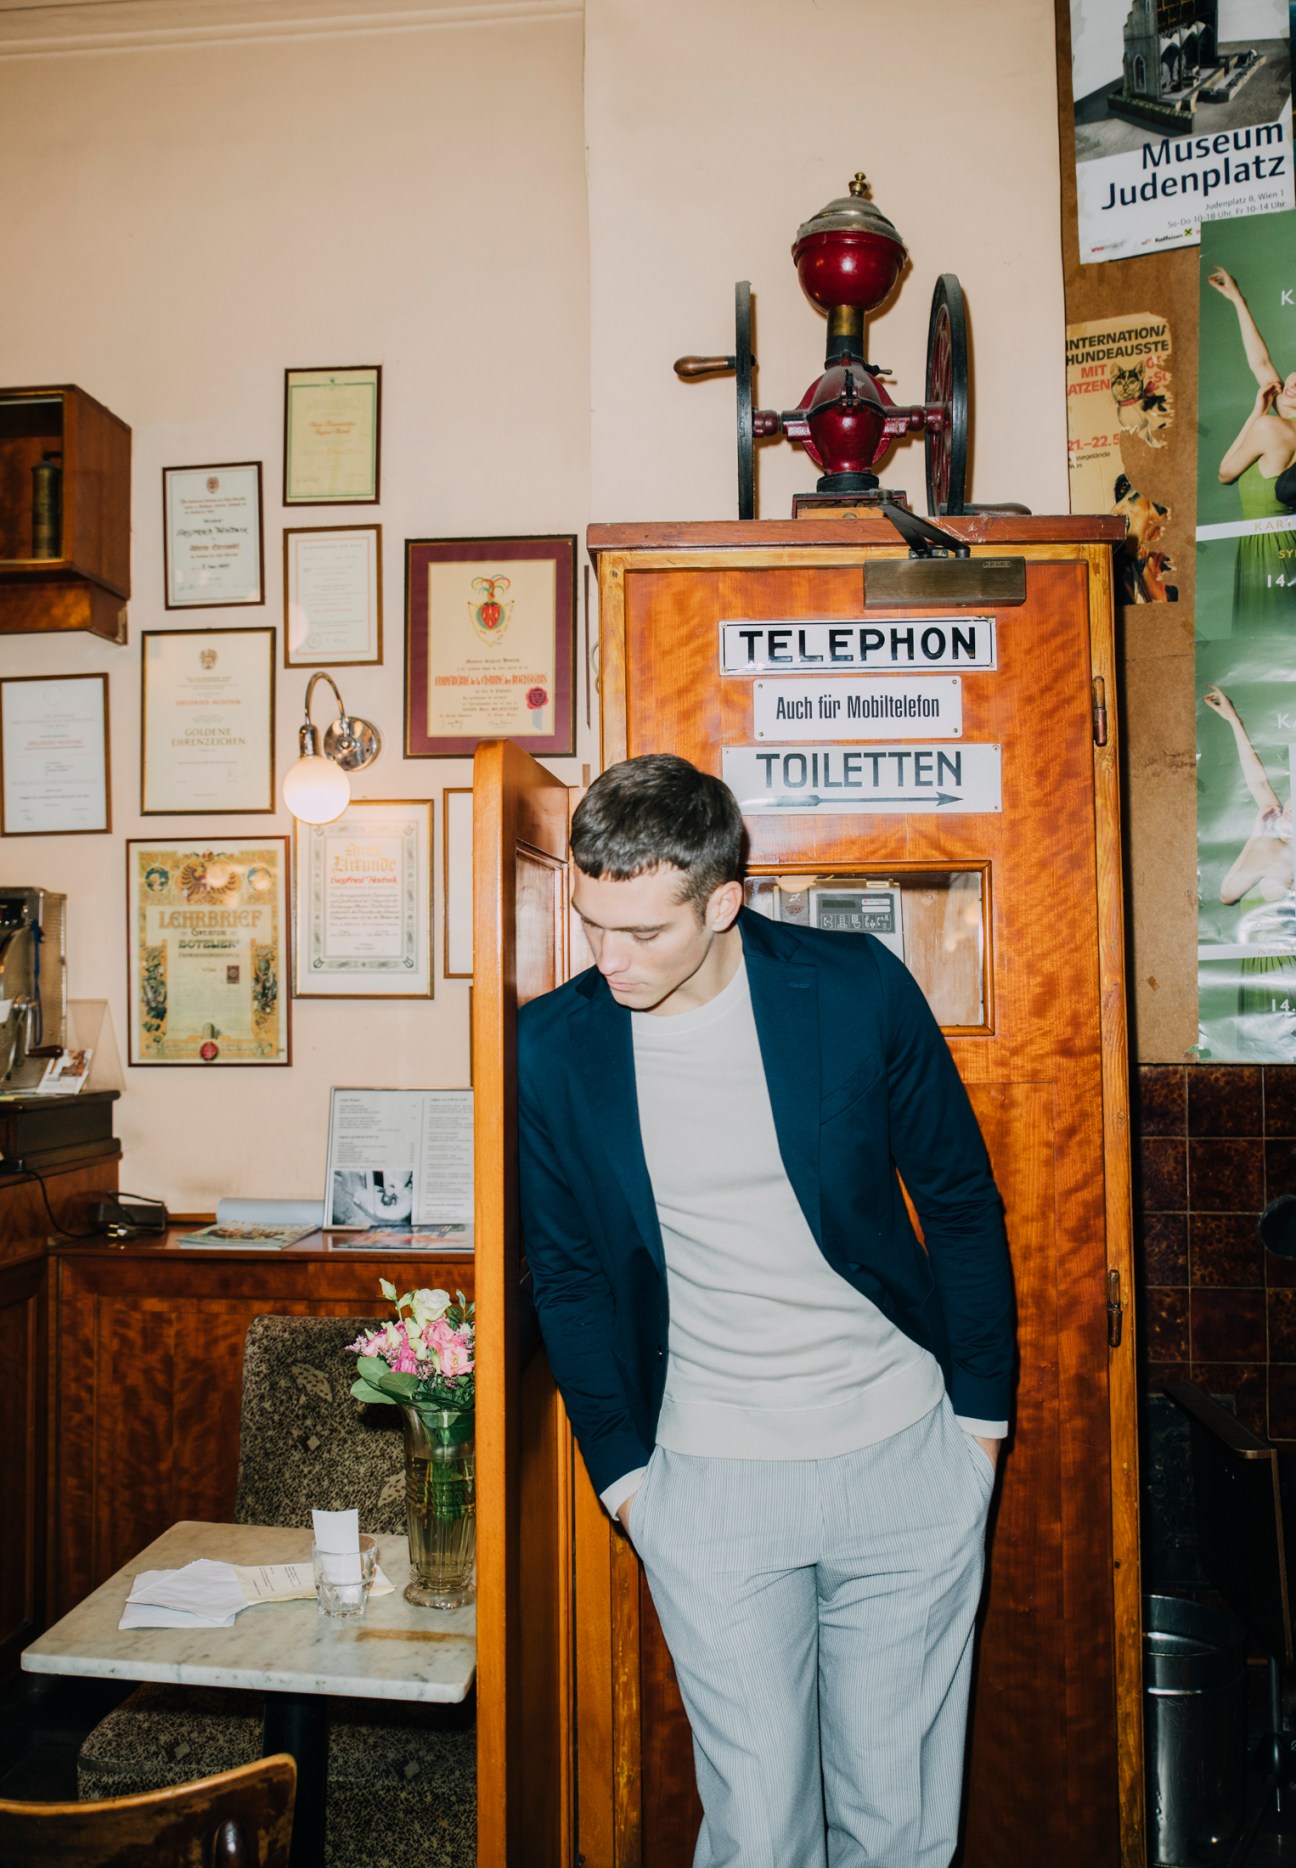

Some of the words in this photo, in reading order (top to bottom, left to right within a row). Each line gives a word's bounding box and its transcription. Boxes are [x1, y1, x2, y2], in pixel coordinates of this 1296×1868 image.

[1142, 122, 1284, 170] Museum
[1101, 155, 1286, 211] Judenplatz
[1205, 196, 1247, 211] Judenplatz
[1258, 191, 1278, 201] Wien
[1280, 189, 1285, 197] 1
[1235, 207, 1244, 215] Fr
[1246, 203, 1269, 213] 10-14
[1270, 200, 1286, 209] Uhr
[1081, 363, 1108, 379] MIT
[739, 626, 977, 664] TELEPHON
[776, 695, 813, 720] Auch
[818, 694, 841, 719] für
[846, 693, 940, 719] Mobiltelefon
[755, 750, 962, 789] TOILETTEN
[158, 909, 263, 929] LEHRBRIEF
